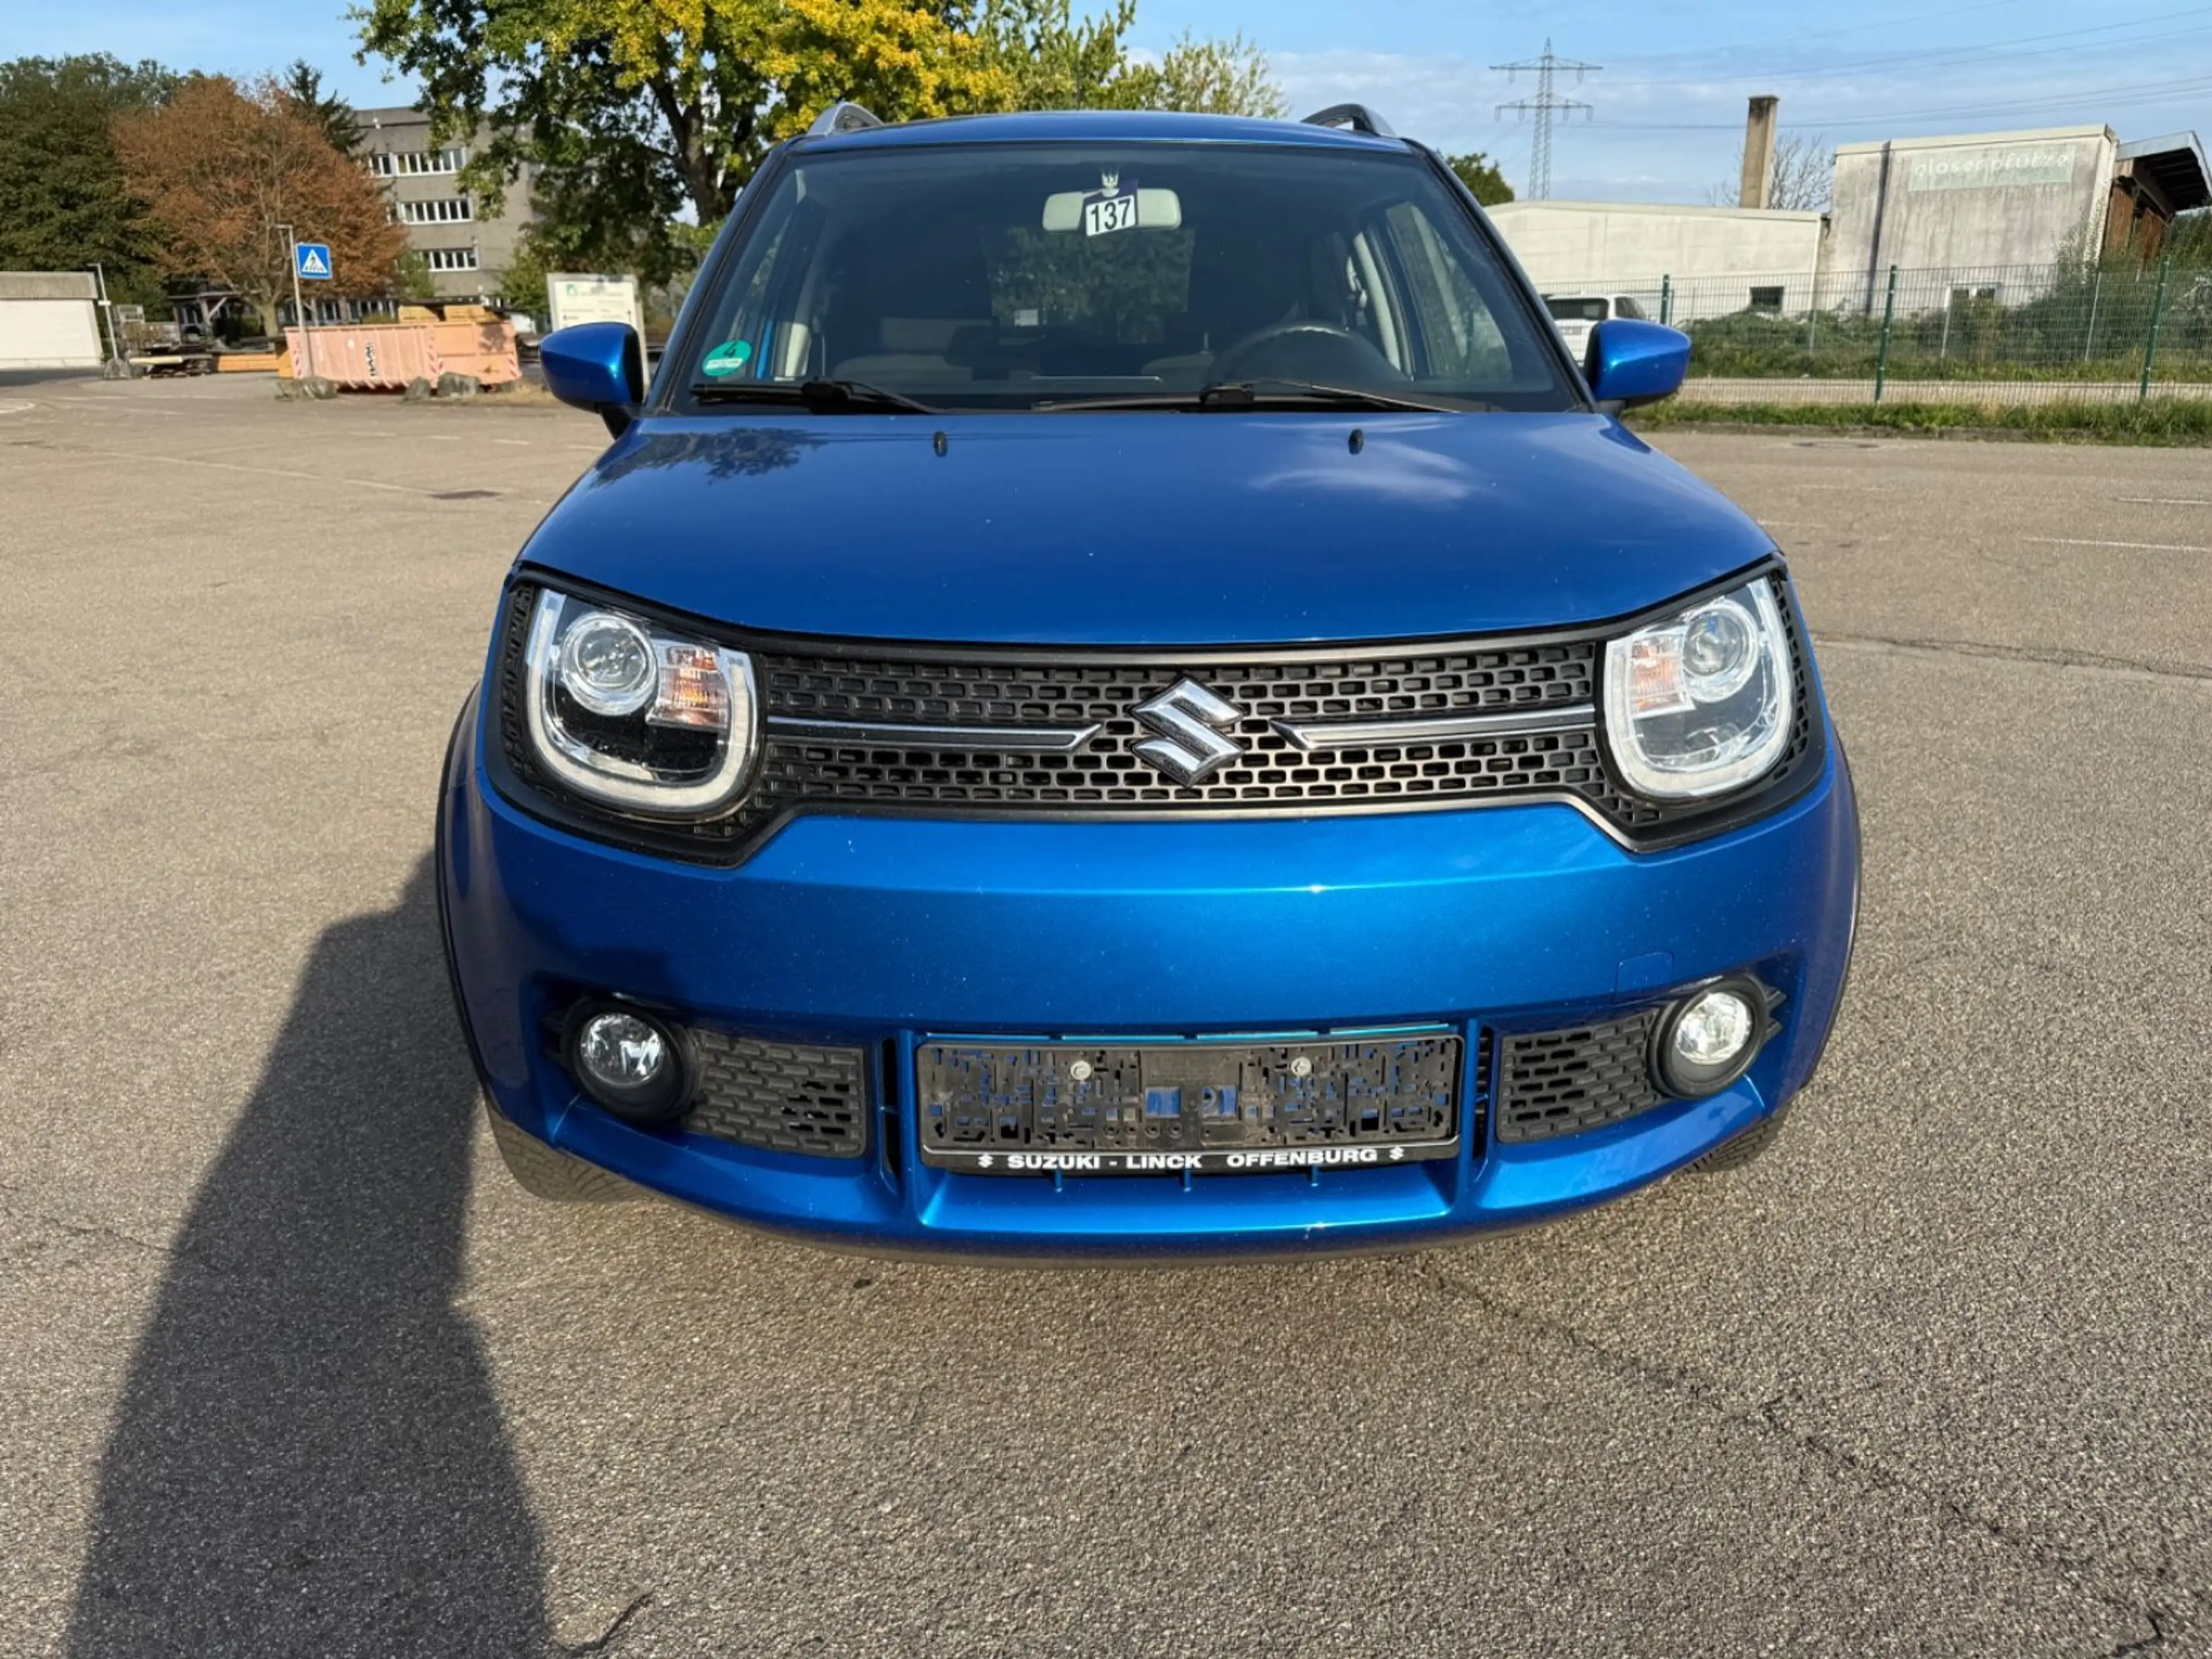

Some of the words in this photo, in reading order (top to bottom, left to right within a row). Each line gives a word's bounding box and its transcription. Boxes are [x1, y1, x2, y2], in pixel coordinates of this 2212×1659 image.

[1090, 199, 1132, 232] 137
[723, 341, 738, 358] 4
[1007, 1154, 1100, 1169] SUZUKI
[1126, 1154, 1202, 1169] LINCK
[1226, 1148, 1377, 1167] OFFENBURG
